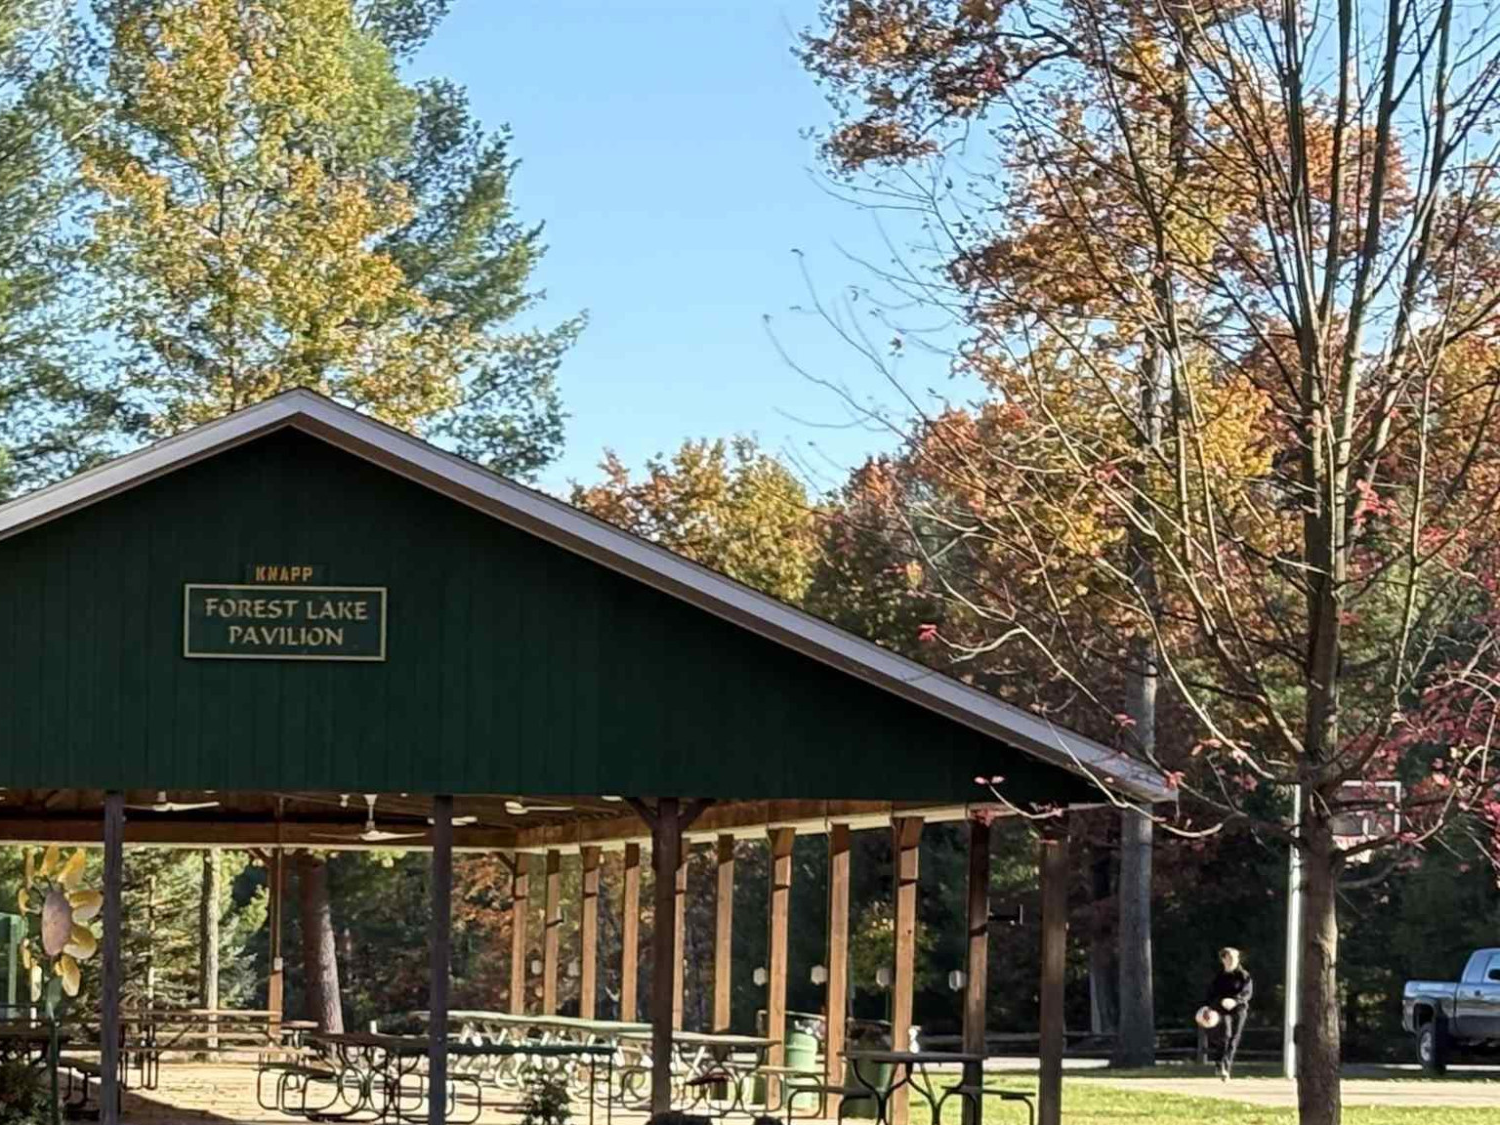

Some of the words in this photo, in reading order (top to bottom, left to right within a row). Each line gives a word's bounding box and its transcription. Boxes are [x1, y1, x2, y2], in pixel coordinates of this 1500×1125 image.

[255, 566, 313, 582] KNAPP
[205, 598, 299, 619] FOREST
[306, 601, 369, 620] LAKE
[228, 625, 344, 646] PAVILION
